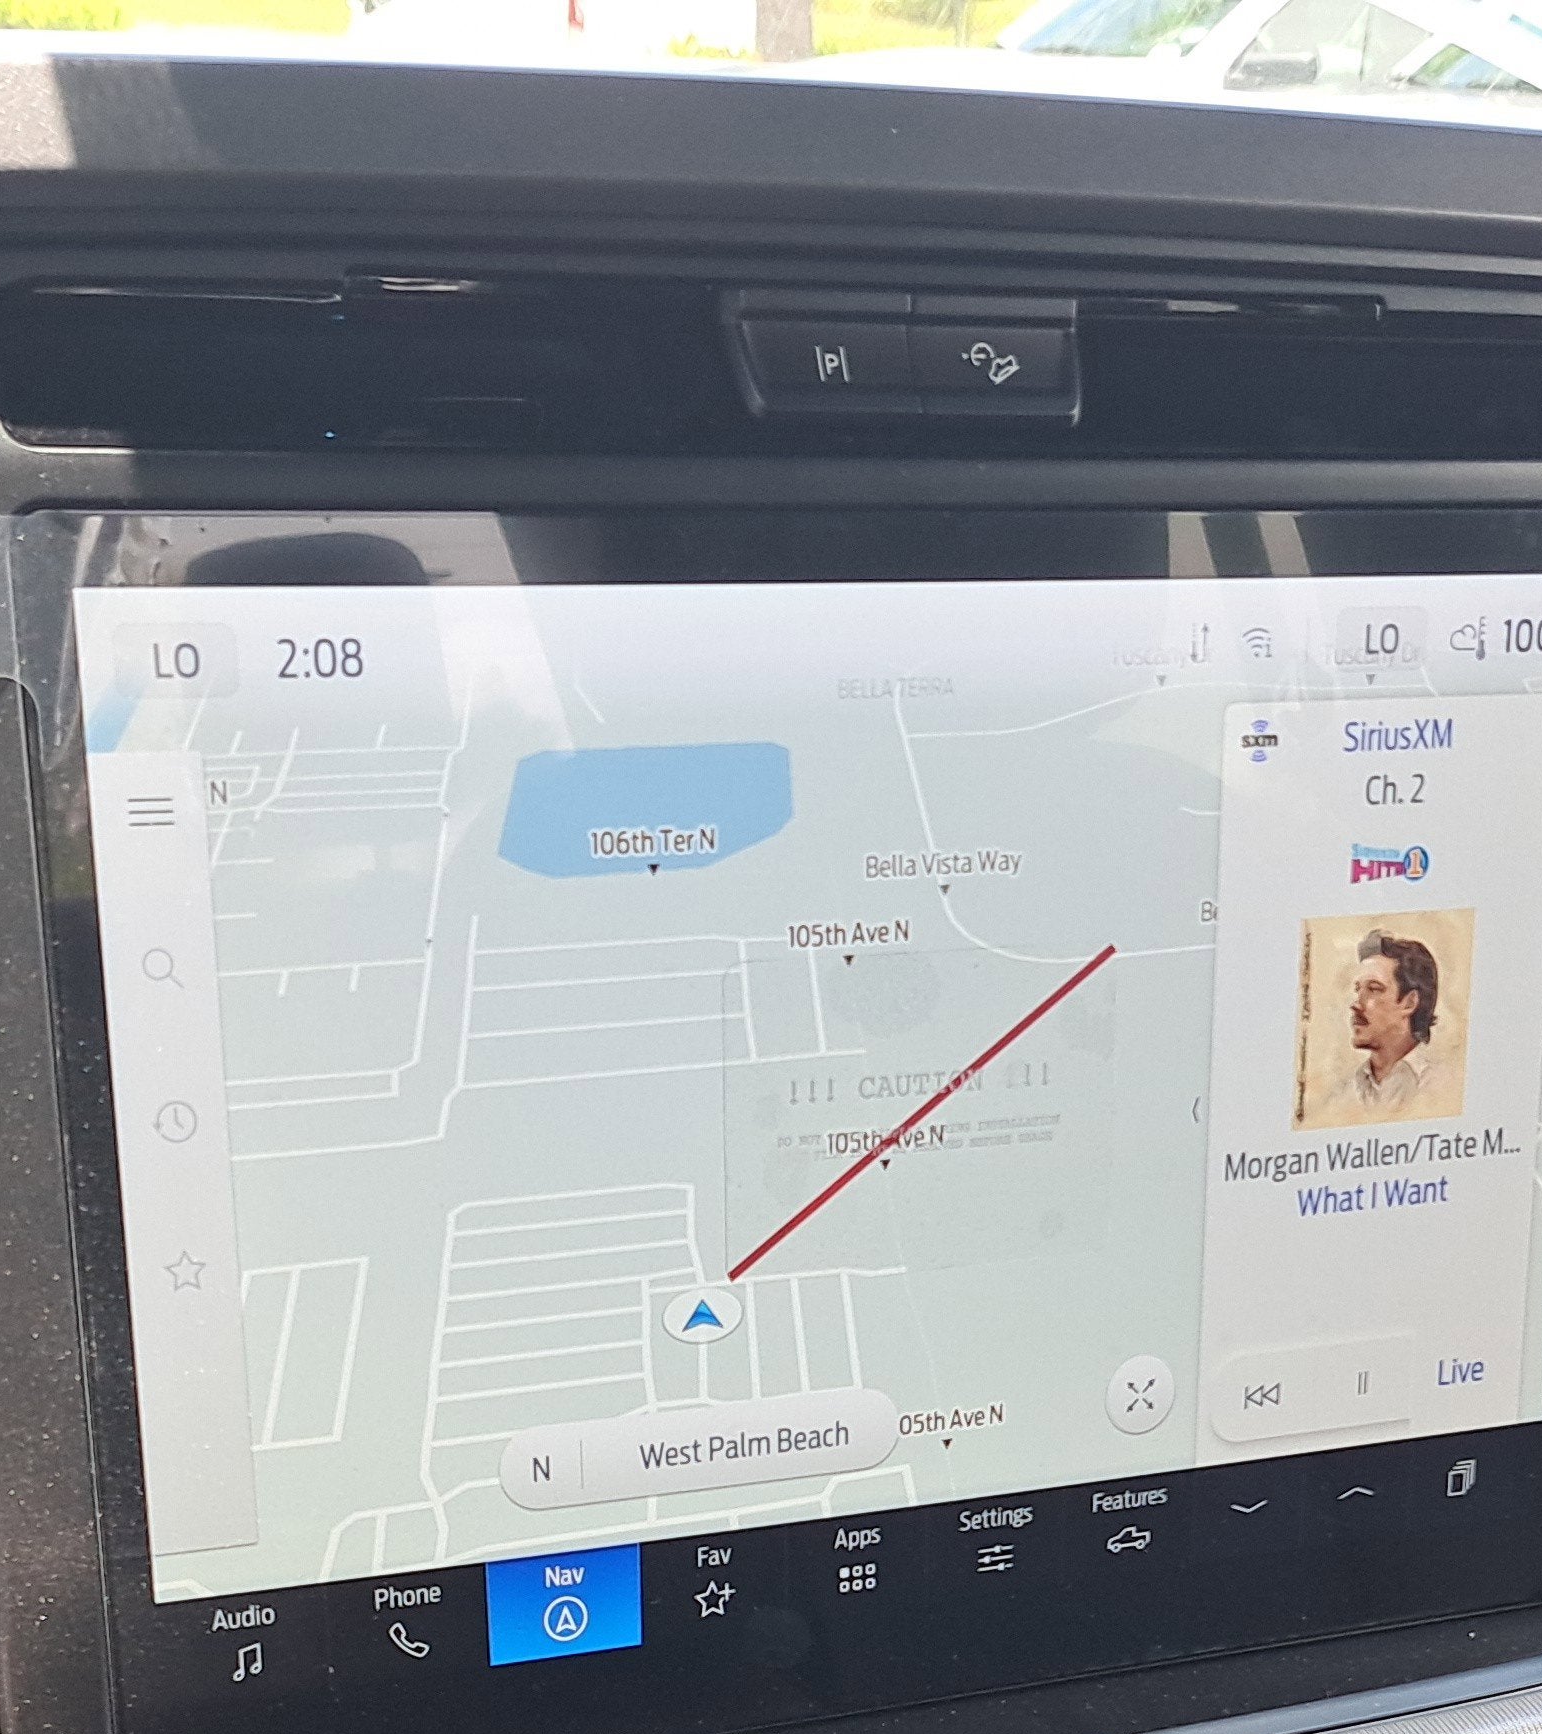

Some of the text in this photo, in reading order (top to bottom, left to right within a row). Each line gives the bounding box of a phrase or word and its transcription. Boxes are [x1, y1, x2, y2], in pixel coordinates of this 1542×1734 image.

[1365, 623, 1399, 655] LO
[152, 642, 201, 680] LO
[276, 638, 364, 680] 2:08
[1344, 718, 1453, 753] SiriusXM
[1365, 774, 1426, 805] Ch. 2
[589, 827, 716, 857] 106th Ter N
[865, 850, 1022, 879] Bella Vista Way
[788, 919, 911, 950] 105th Ave N
[858, 1069, 983, 1100] CAUTION
[827, 1131, 883, 1155] 105th
[929, 1123, 945, 1145] N
[1224, 1149, 1320, 1184] Morgan
[1326, 1133, 1477, 1172] Wallen/Tate
[1297, 1176, 1449, 1217] What I Want
[1437, 1357, 1484, 1387] Live
[950, 1408, 985, 1429] Ave
[989, 1403, 1004, 1424] N
[640, 1421, 850, 1471] West Palm Beach
[533, 1456, 551, 1482] N
[1091, 1485, 1168, 1512] Features
[958, 1502, 1034, 1533] Settings
[834, 1523, 881, 1552] Apps
[696, 1543, 733, 1568] Fav
[545, 1563, 584, 1589] Nav
[374, 1582, 441, 1612] Phone
[212, 1604, 275, 1632] Audio
